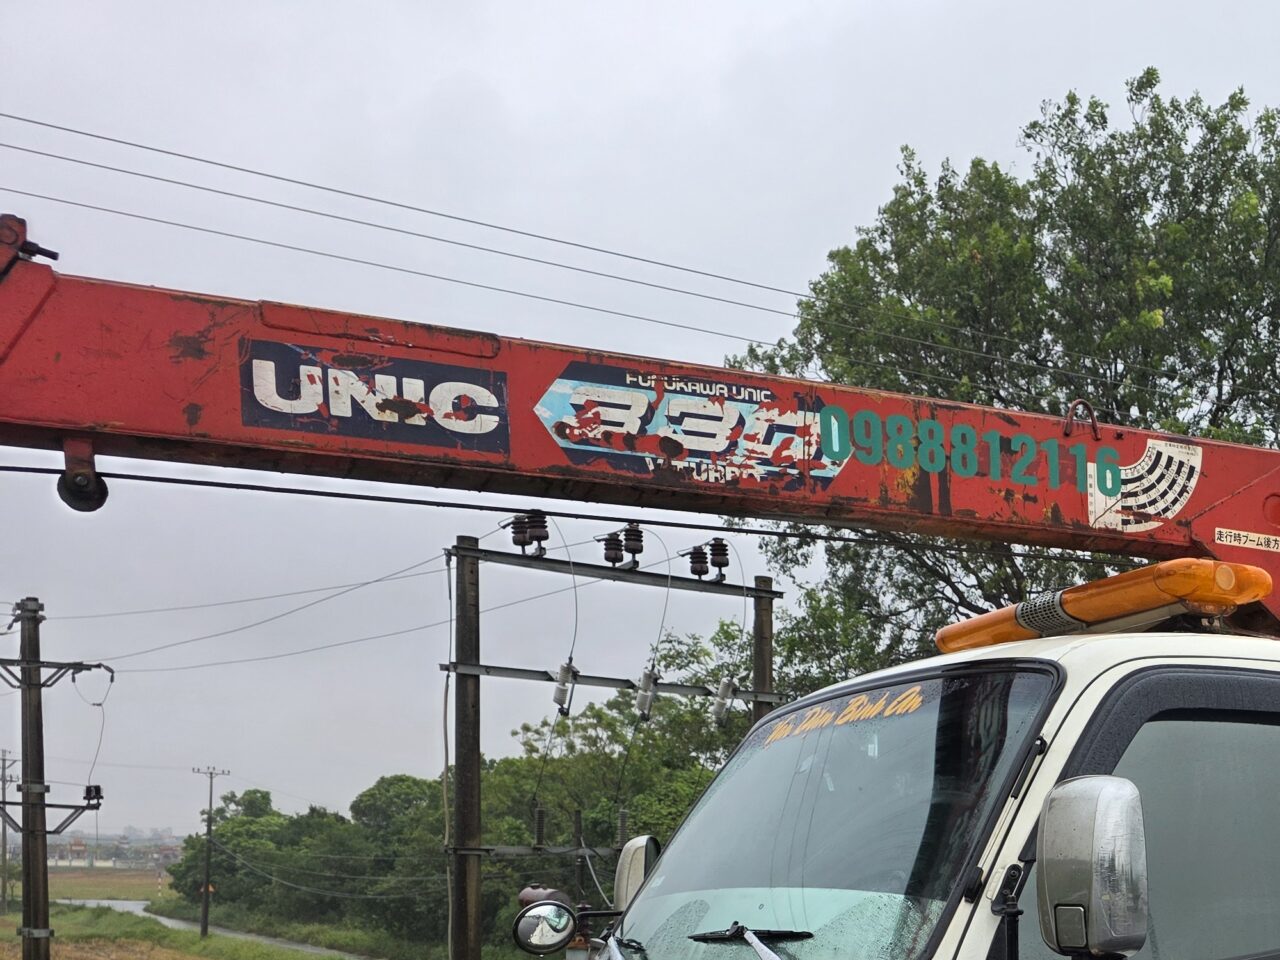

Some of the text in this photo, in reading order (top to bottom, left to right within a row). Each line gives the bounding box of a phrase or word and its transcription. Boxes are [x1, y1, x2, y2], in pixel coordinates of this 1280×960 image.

[253, 358, 500, 433] UNIC
[731, 385, 772, 402] UNIC
[819, 405, 1121, 497] 0988812116
[1216, 530, 1280, 550] 走行時ブーム後方
